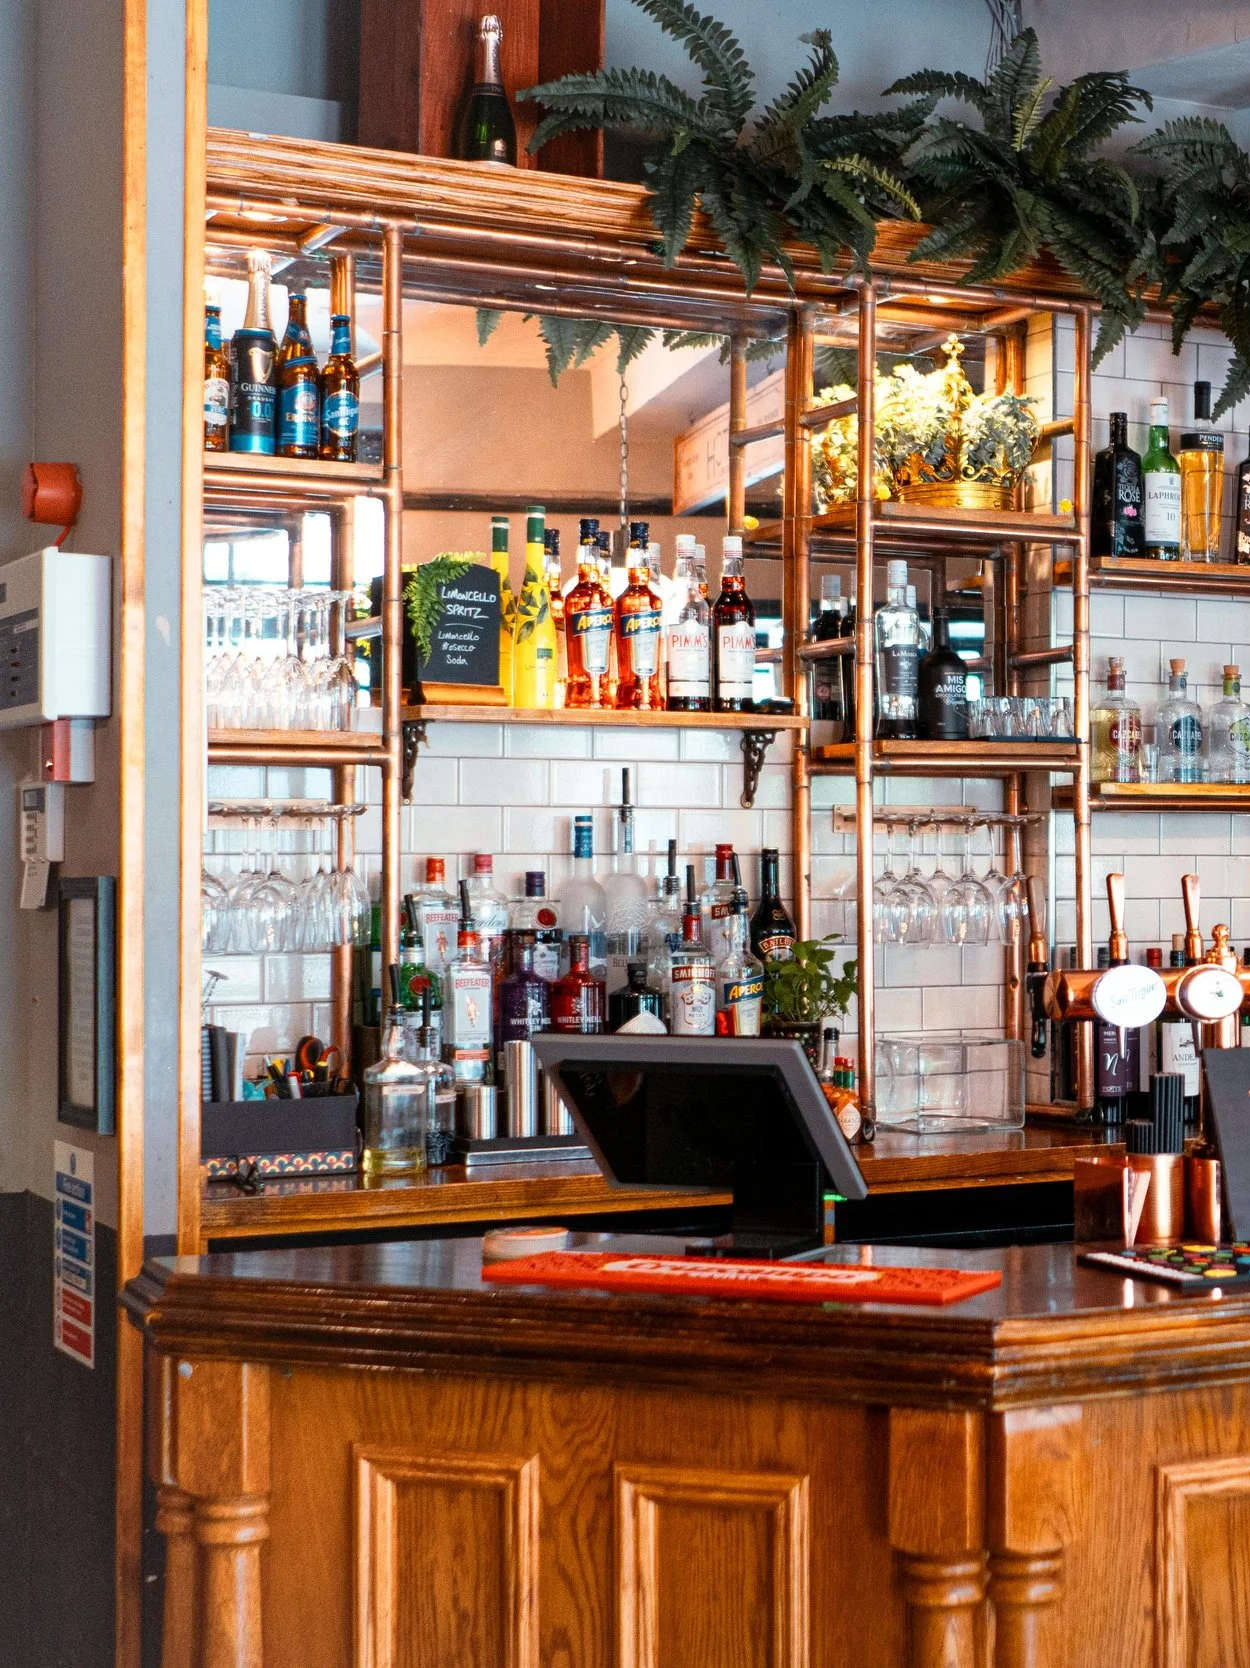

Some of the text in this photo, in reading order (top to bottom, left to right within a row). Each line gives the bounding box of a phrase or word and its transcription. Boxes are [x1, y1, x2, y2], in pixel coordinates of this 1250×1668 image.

[251, 401, 271, 418] 0.0
[1118, 490, 1141, 503] ROSE
[446, 604, 490, 619] SPRITZ
[577, 613, 613, 631] APERO
[625, 614, 662, 633] APERO
[446, 654, 469, 666] Soda
[947, 675, 964, 684] MIS
[935, 684, 966, 693] AMIGO
[426, 913, 459, 924] BEEFEATER
[674, 968, 716, 979] SMIRNOFF
[455, 978, 489, 989] BEEFEATER
[729, 982, 763, 1000] APERO
[1172, 1054, 1195, 1062] ANDE
